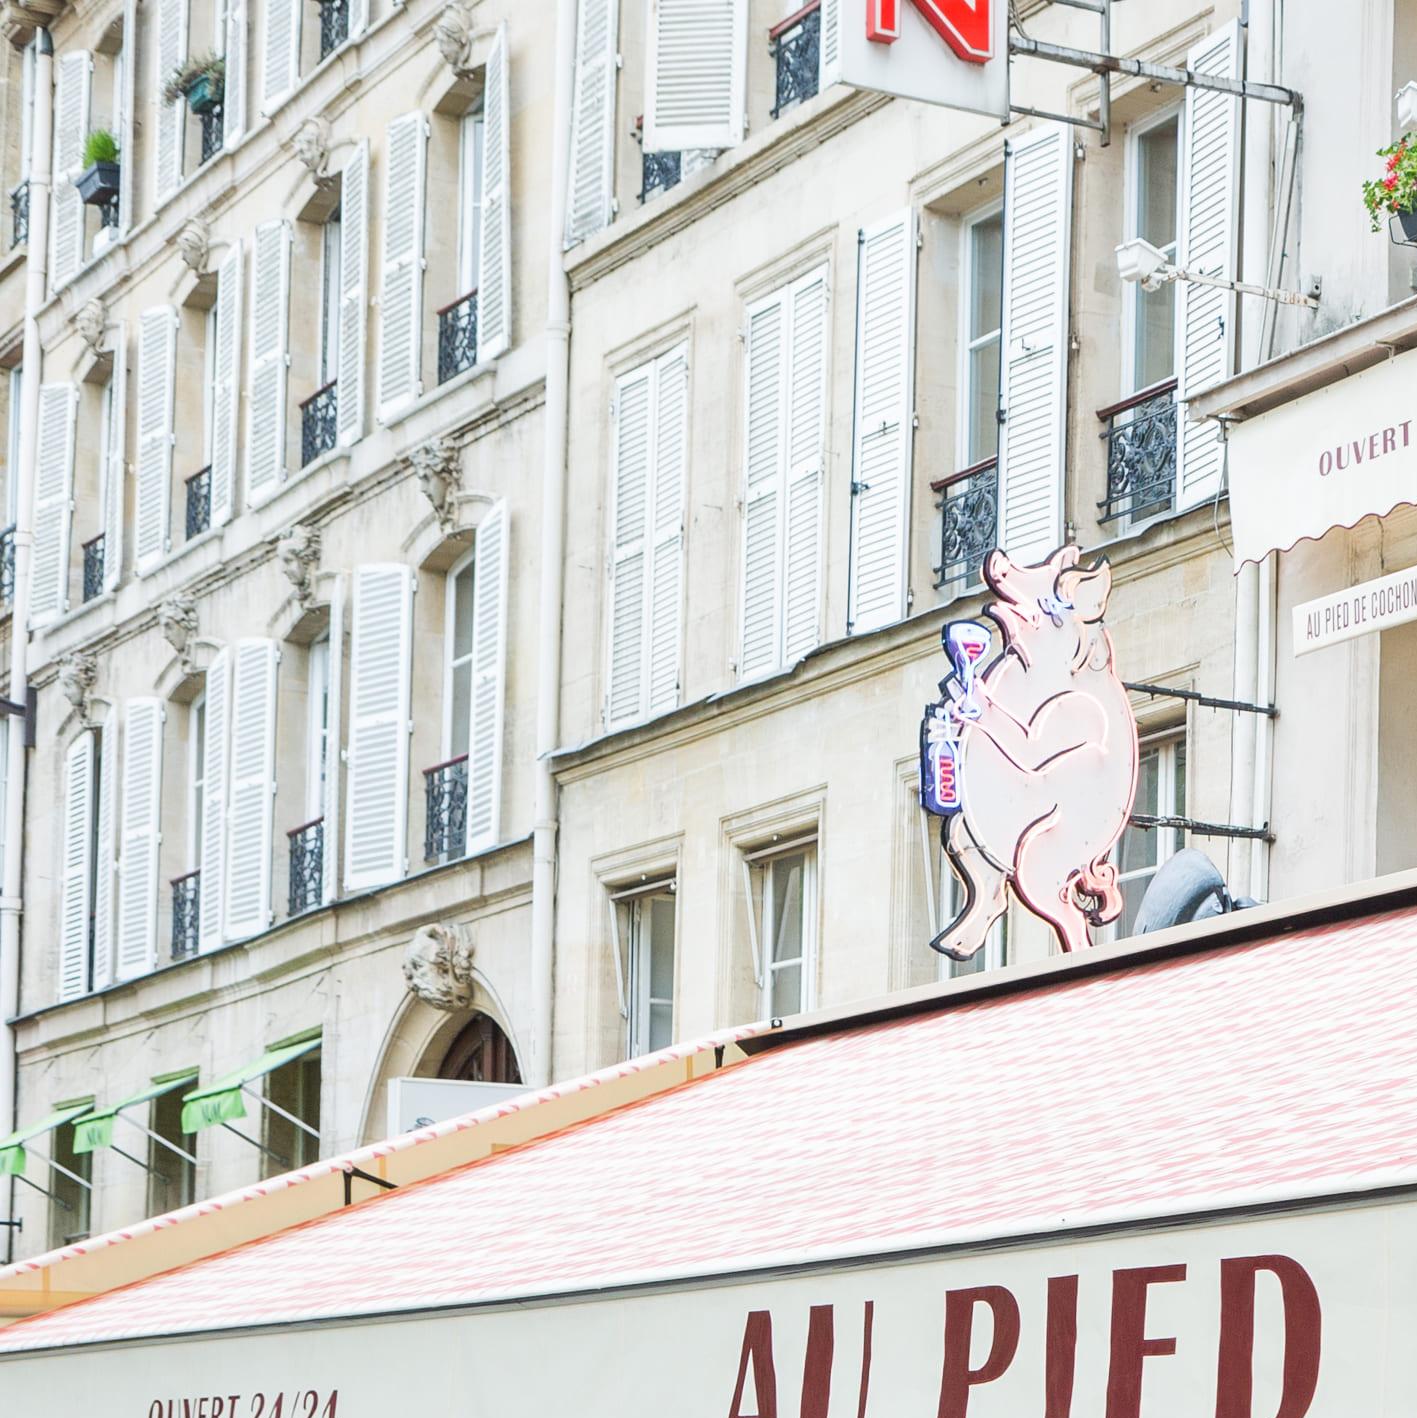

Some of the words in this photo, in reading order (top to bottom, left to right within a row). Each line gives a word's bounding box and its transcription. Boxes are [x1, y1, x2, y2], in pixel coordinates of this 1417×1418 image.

[1318, 420, 1413, 478] OUVERT
[1307, 610, 1321, 640] AU
[1325, 602, 1349, 634] PIED
[1354, 595, 1367, 624] DE
[1371, 579, 1417, 619] COCHON
